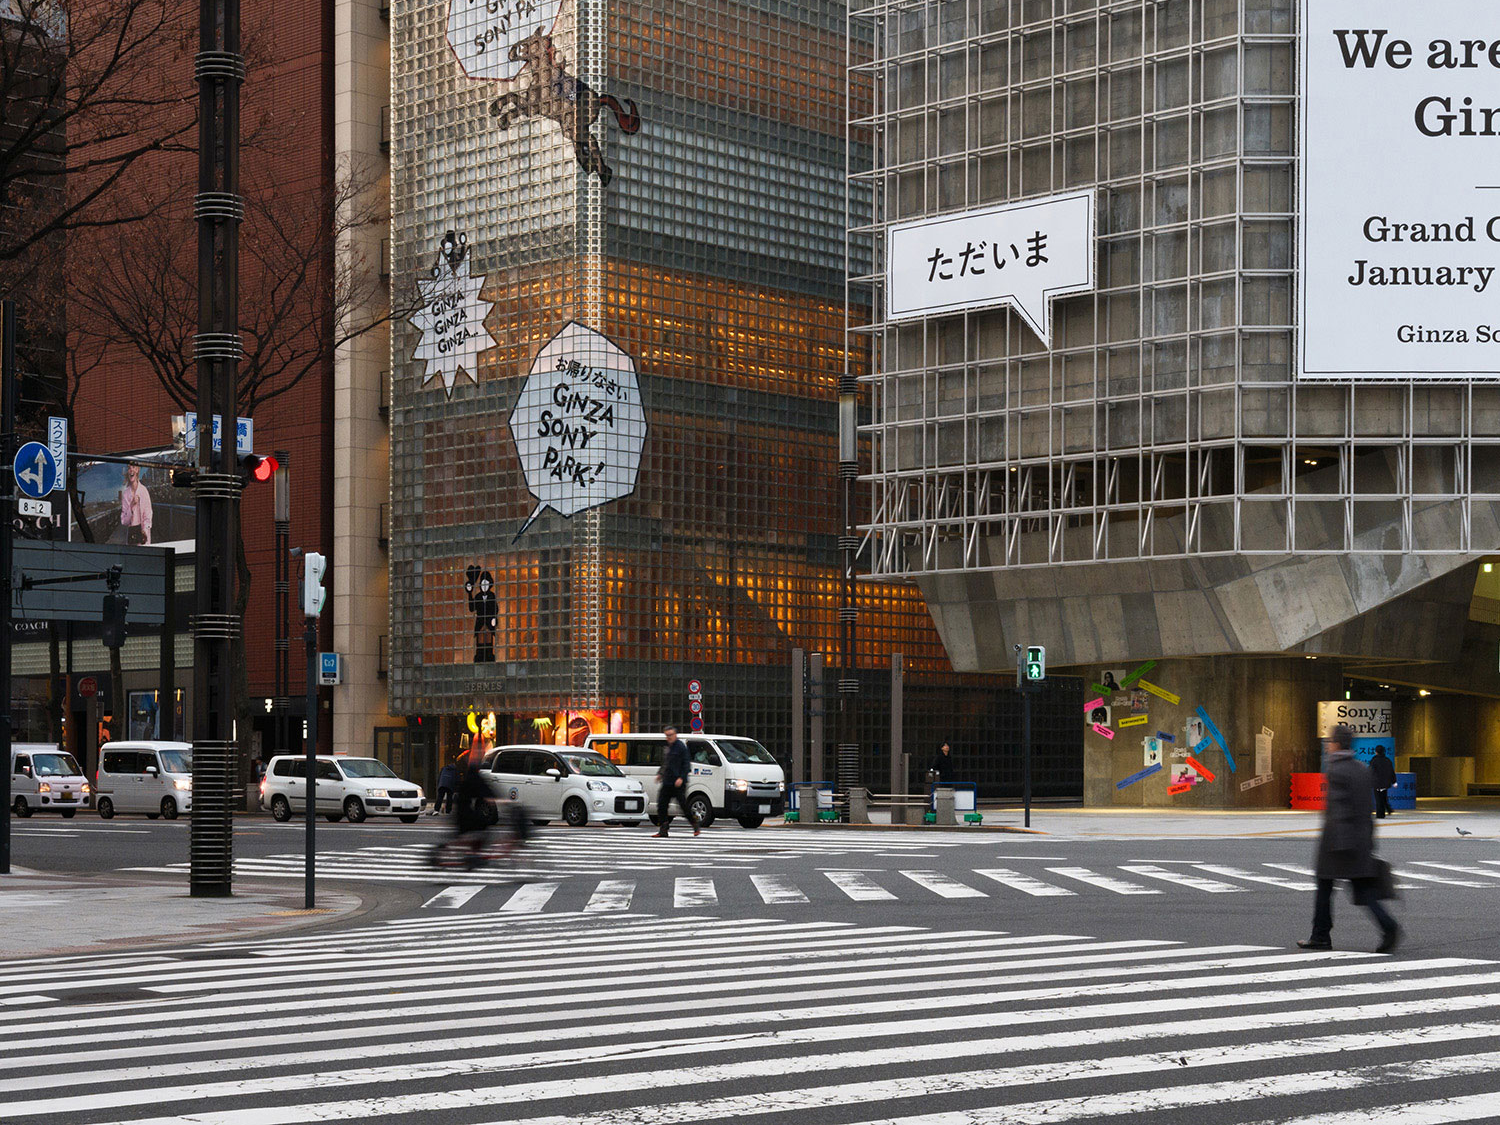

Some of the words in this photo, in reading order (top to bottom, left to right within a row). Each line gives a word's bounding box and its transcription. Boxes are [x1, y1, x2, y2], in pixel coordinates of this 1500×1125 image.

[474, 9, 512, 55] SONY
[1332, 28, 1413, 70] We
[1362, 216, 1477, 243] Grand
[926, 230, 1049, 282] ただいま
[1347, 259, 1495, 293] January
[431, 290, 465, 316] GINZA
[434, 308, 467, 335] GINZA
[1396, 324, 1470, 344] Ginza
[555, 356, 628, 401] お帰りなさい
[553, 382, 614, 428] GINZA
[537, 409, 599, 450] SONY
[543, 446, 606, 488] PARK!
[14, 621, 49, 631] COACH
[1337, 705, 1378, 721] Sony
